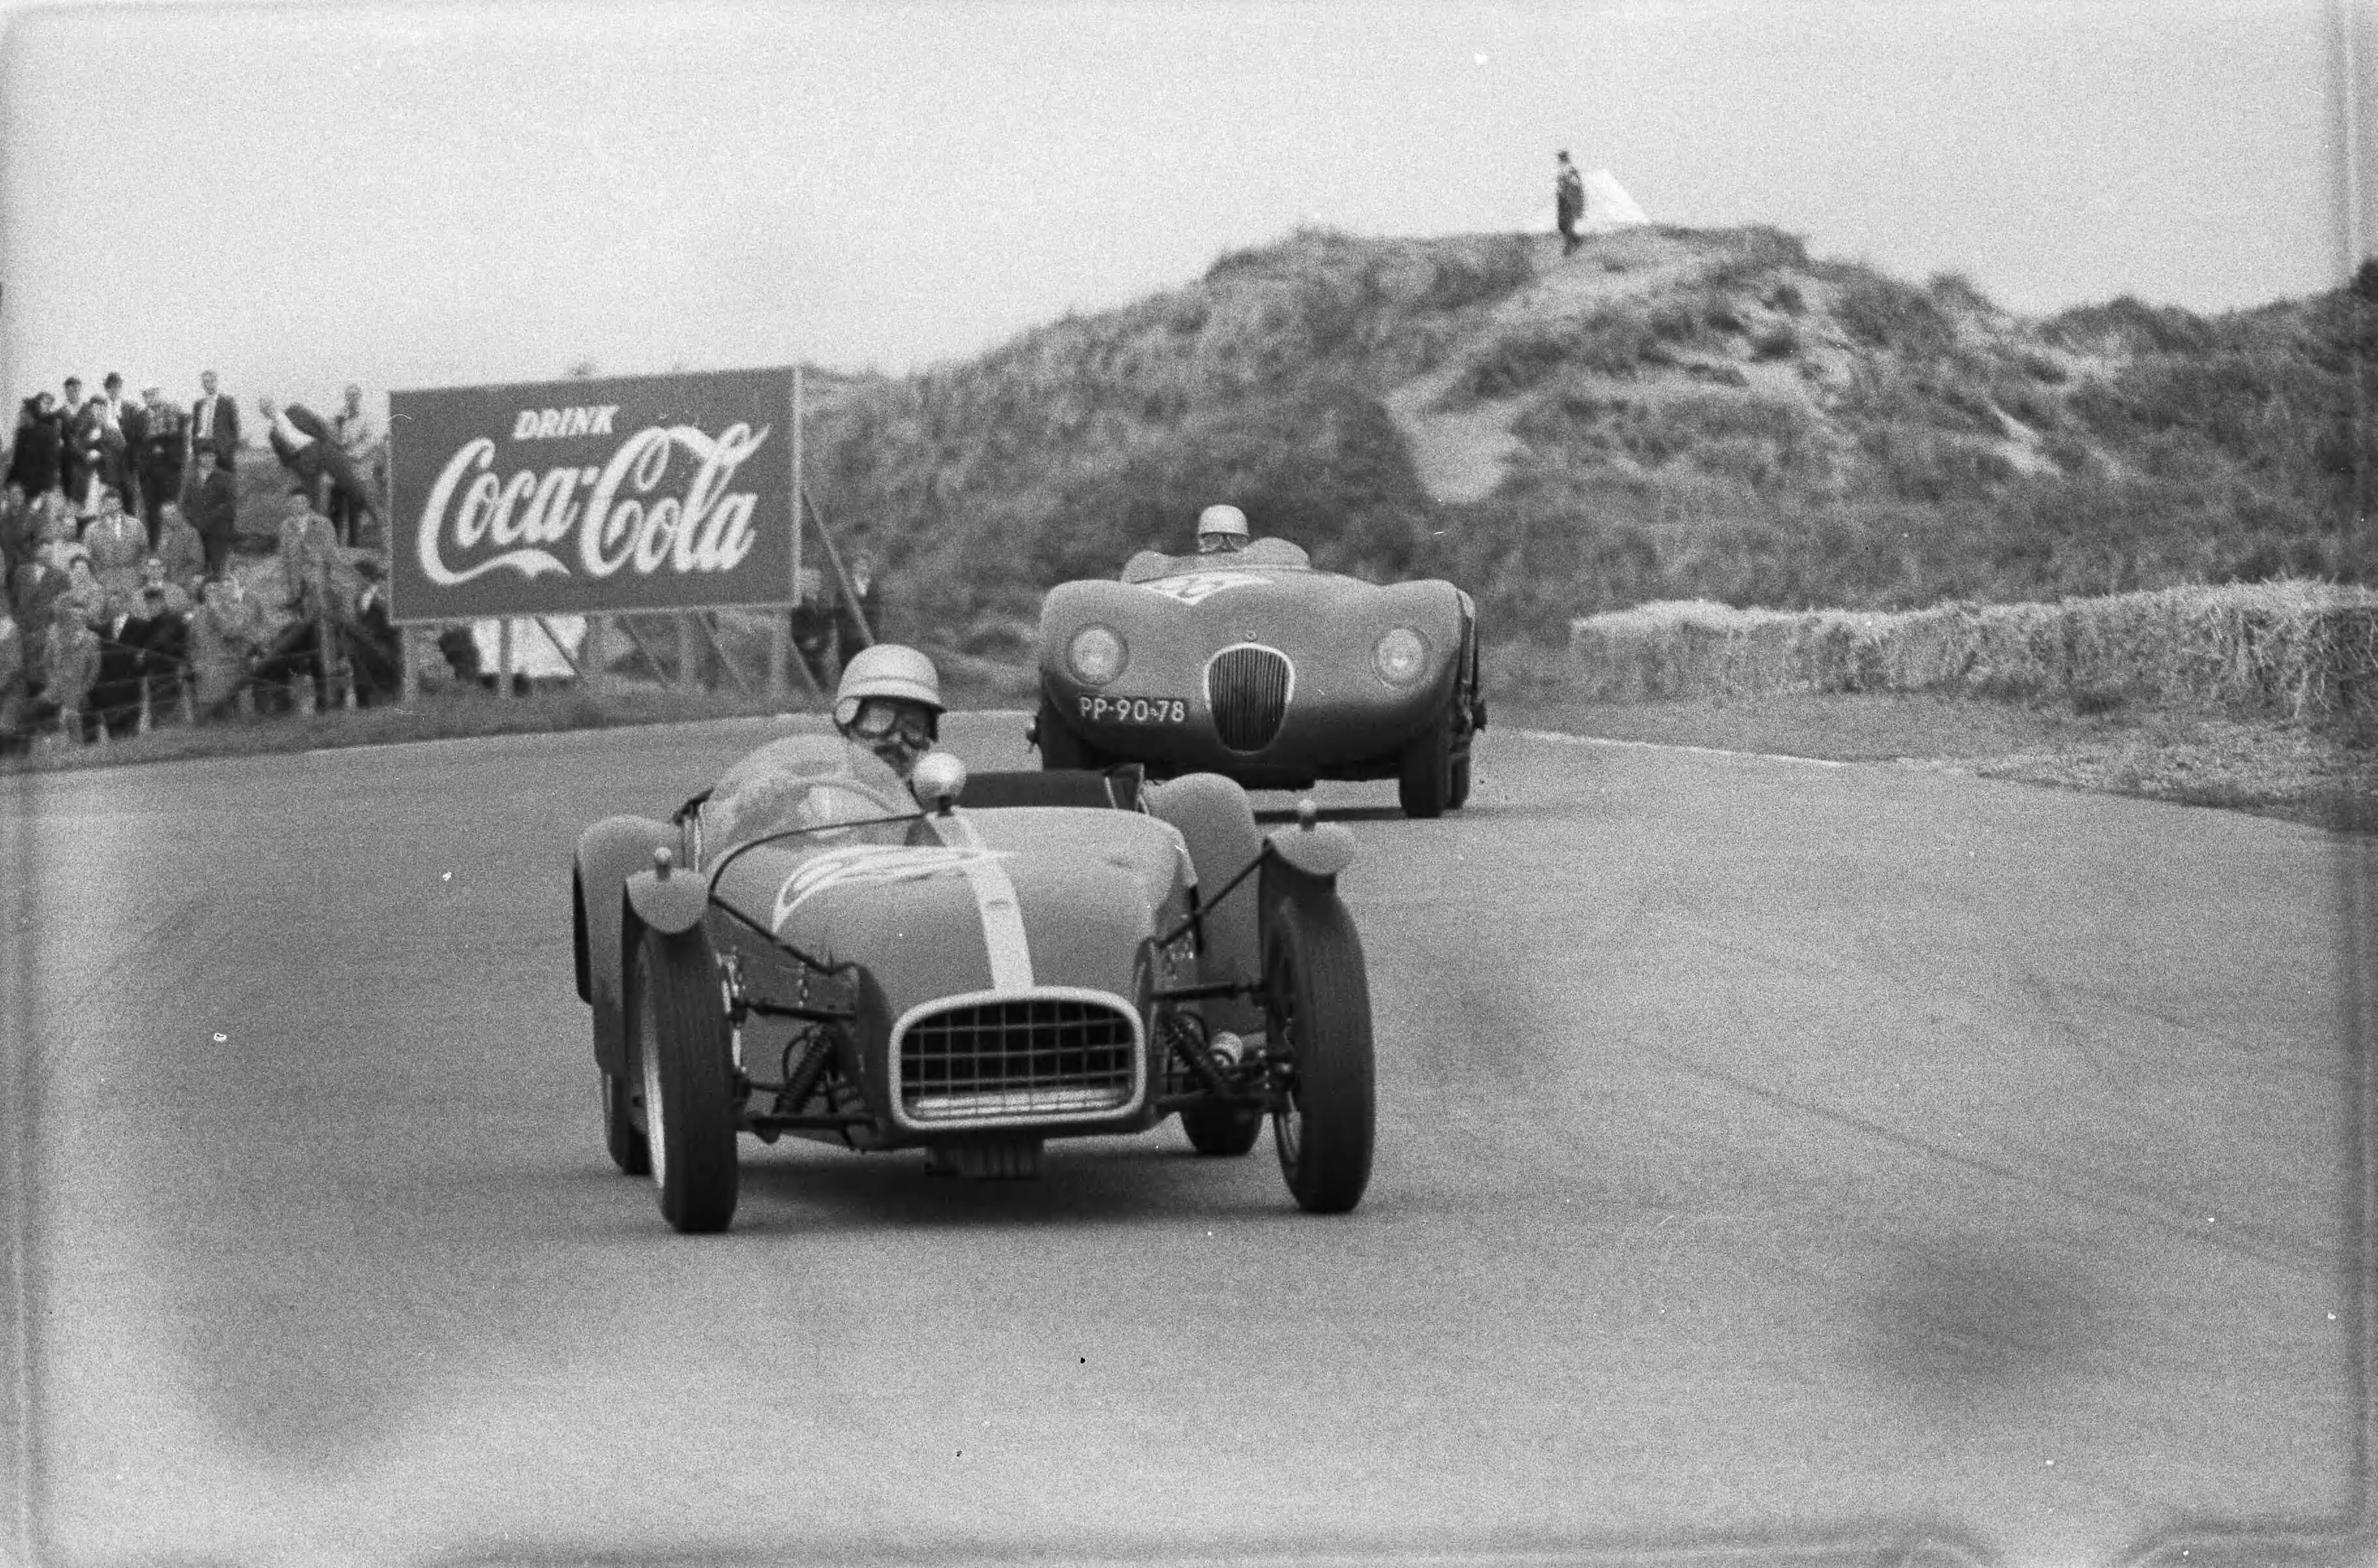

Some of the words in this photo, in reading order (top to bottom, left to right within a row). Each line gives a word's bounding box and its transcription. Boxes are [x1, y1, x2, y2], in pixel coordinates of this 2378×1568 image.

[513, 405, 620, 440] DRINK
[417, 422, 771, 585] Coca-Cola
[1079, 696, 1186, 722] PP-90-78
